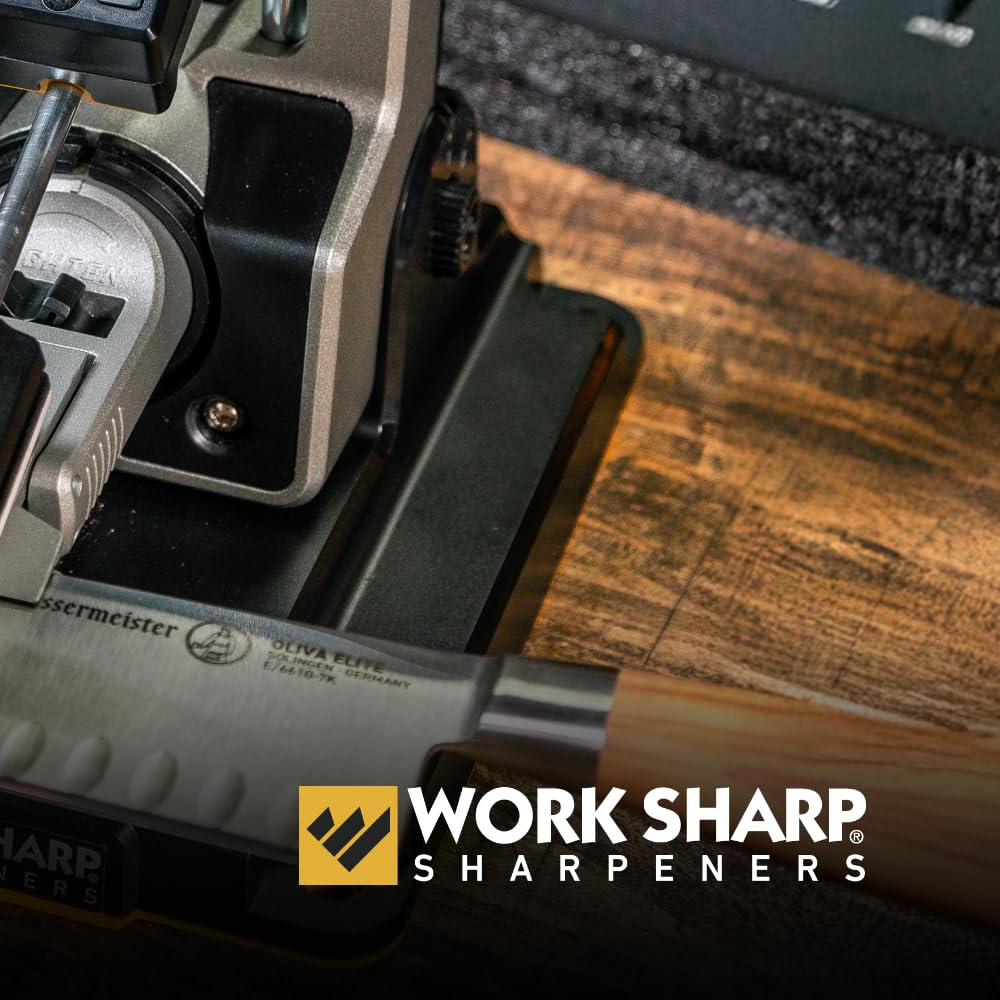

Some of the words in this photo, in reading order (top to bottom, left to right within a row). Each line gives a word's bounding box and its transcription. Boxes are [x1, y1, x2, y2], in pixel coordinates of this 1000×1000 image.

[40, 597, 179, 638] ssermeister
[266, 650, 335, 672] SOLINGEN
[345, 668, 412, 690] GERMANY
[271, 639, 327, 660] OLIVA
[333, 651, 386, 673] ELITE
